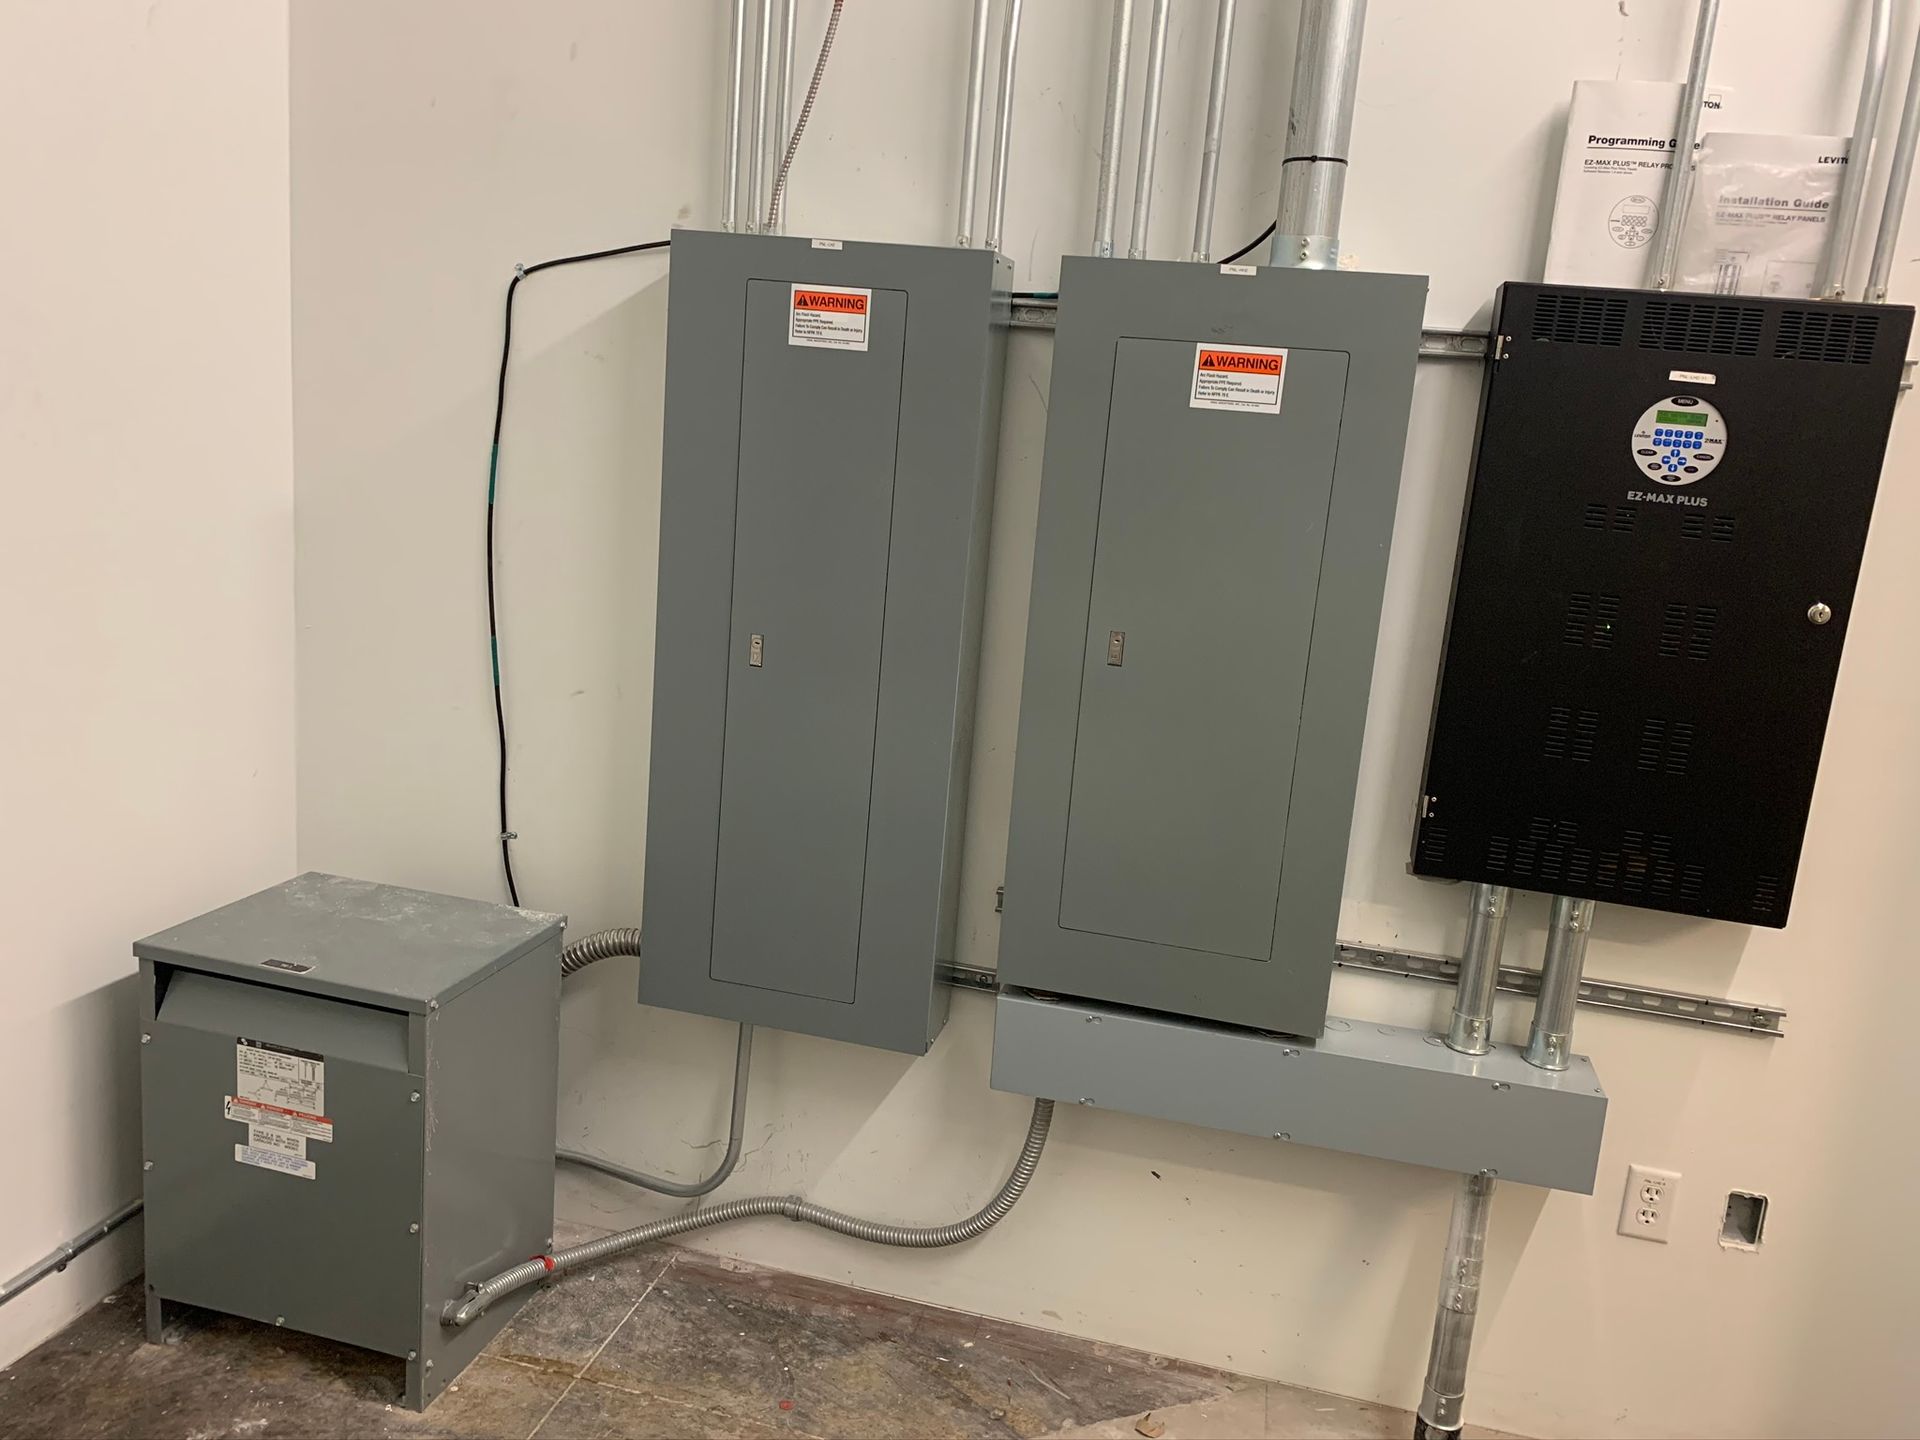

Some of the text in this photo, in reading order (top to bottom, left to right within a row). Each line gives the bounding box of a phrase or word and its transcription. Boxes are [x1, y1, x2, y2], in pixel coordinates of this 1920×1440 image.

[1588, 135, 1666, 148] Programming
[1719, 194, 1830, 209] Installation Guide
[1797, 215, 1825, 223] PANELS
[809, 295, 864, 310] WARNING
[1216, 356, 1279, 371] WARNING
[1627, 490, 1708, 507] EZ-MAX PLUS
